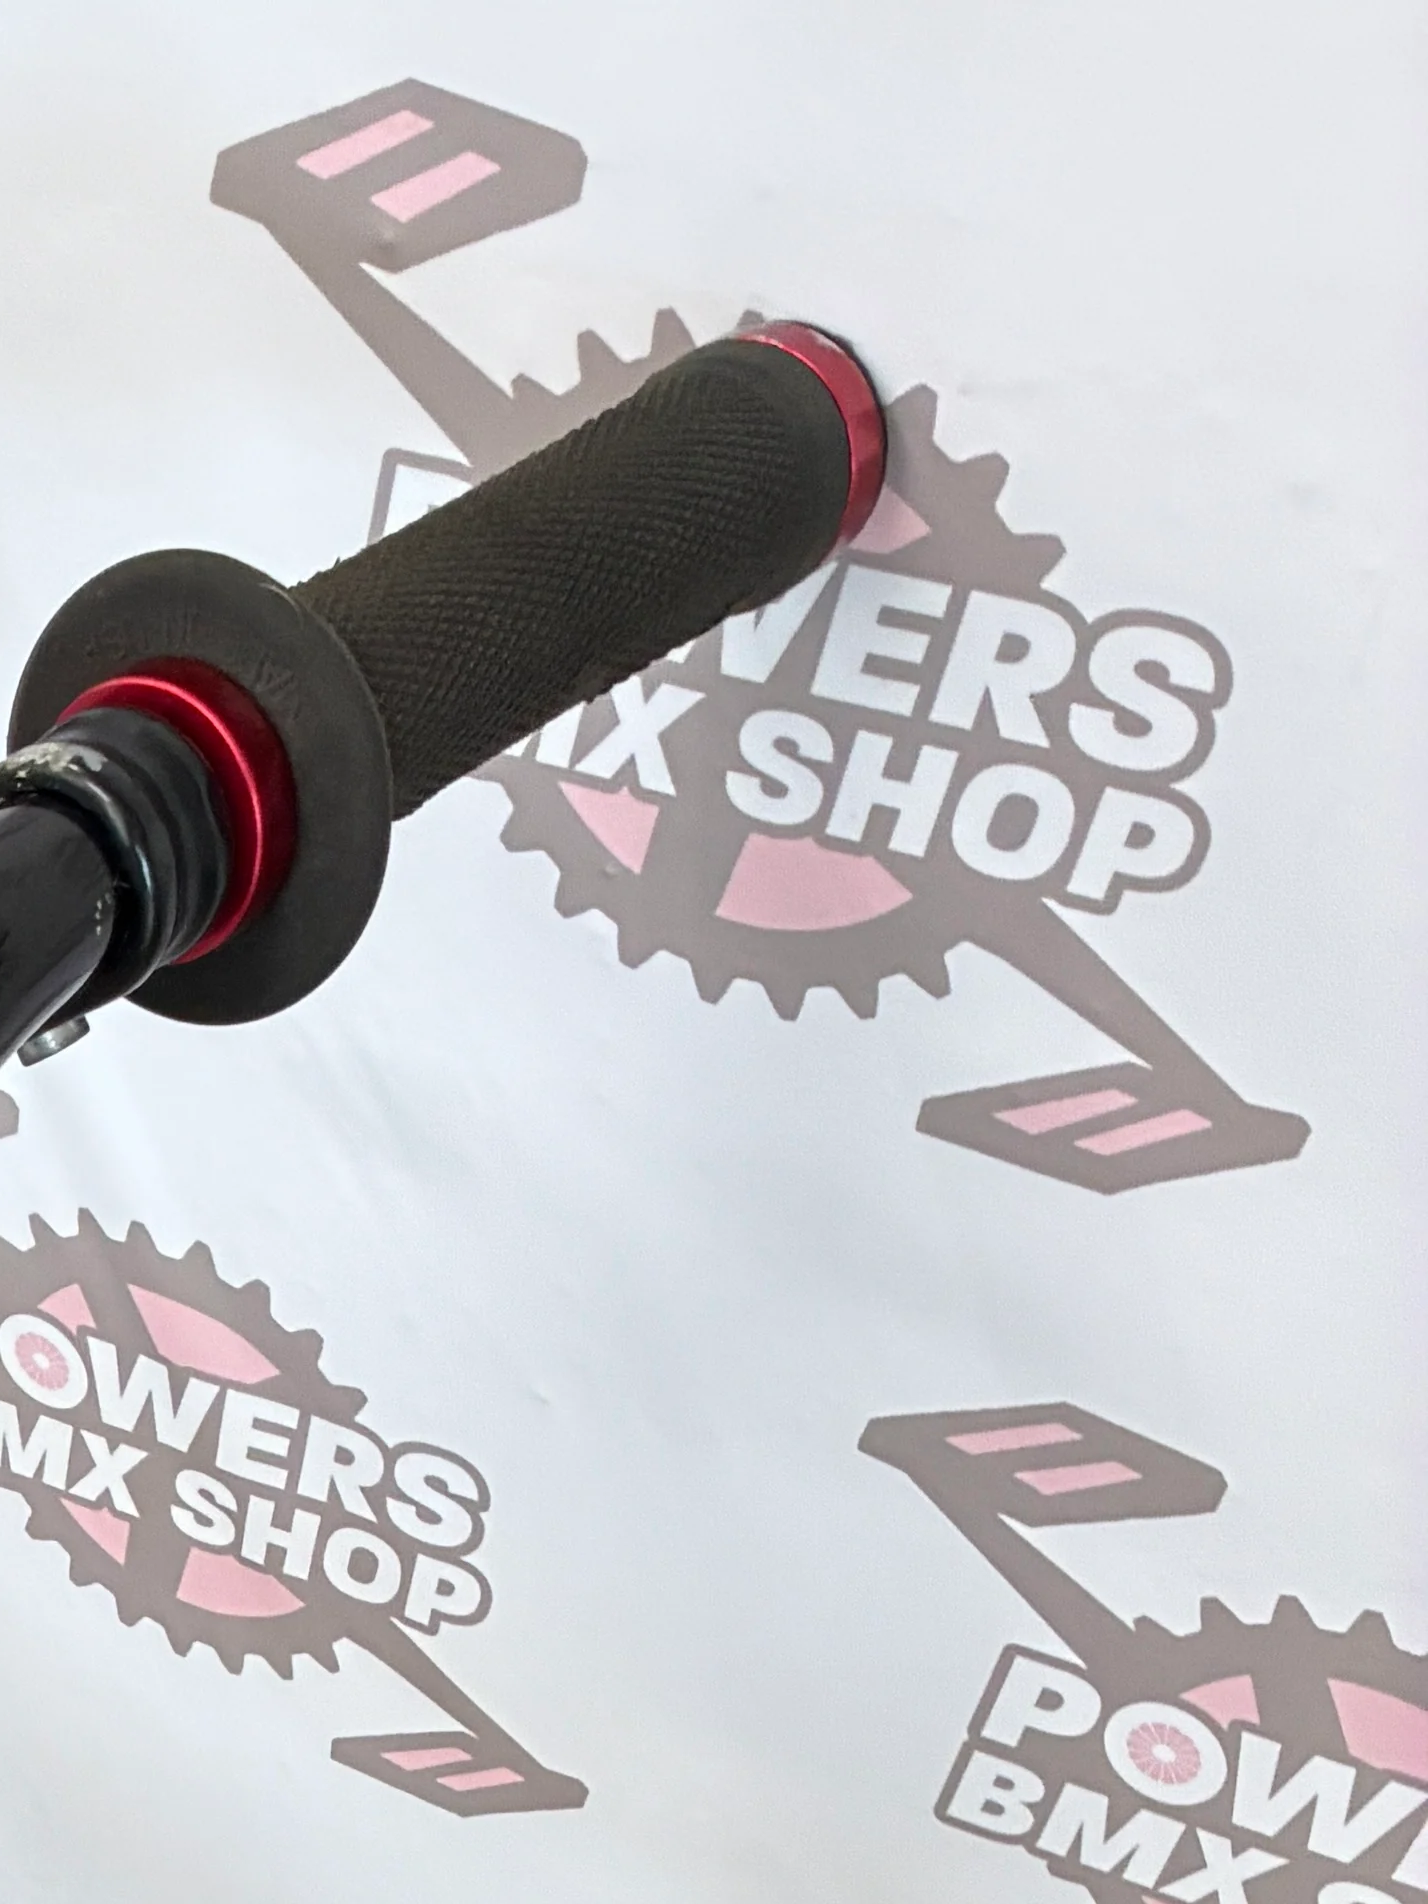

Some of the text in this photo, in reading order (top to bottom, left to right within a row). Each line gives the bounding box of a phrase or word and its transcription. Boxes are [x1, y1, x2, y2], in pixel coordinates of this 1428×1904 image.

[724, 708, 1197, 902] SHOP
[169, 1470, 484, 1629] SHOP
[979, 1652, 1428, 1890] POW
